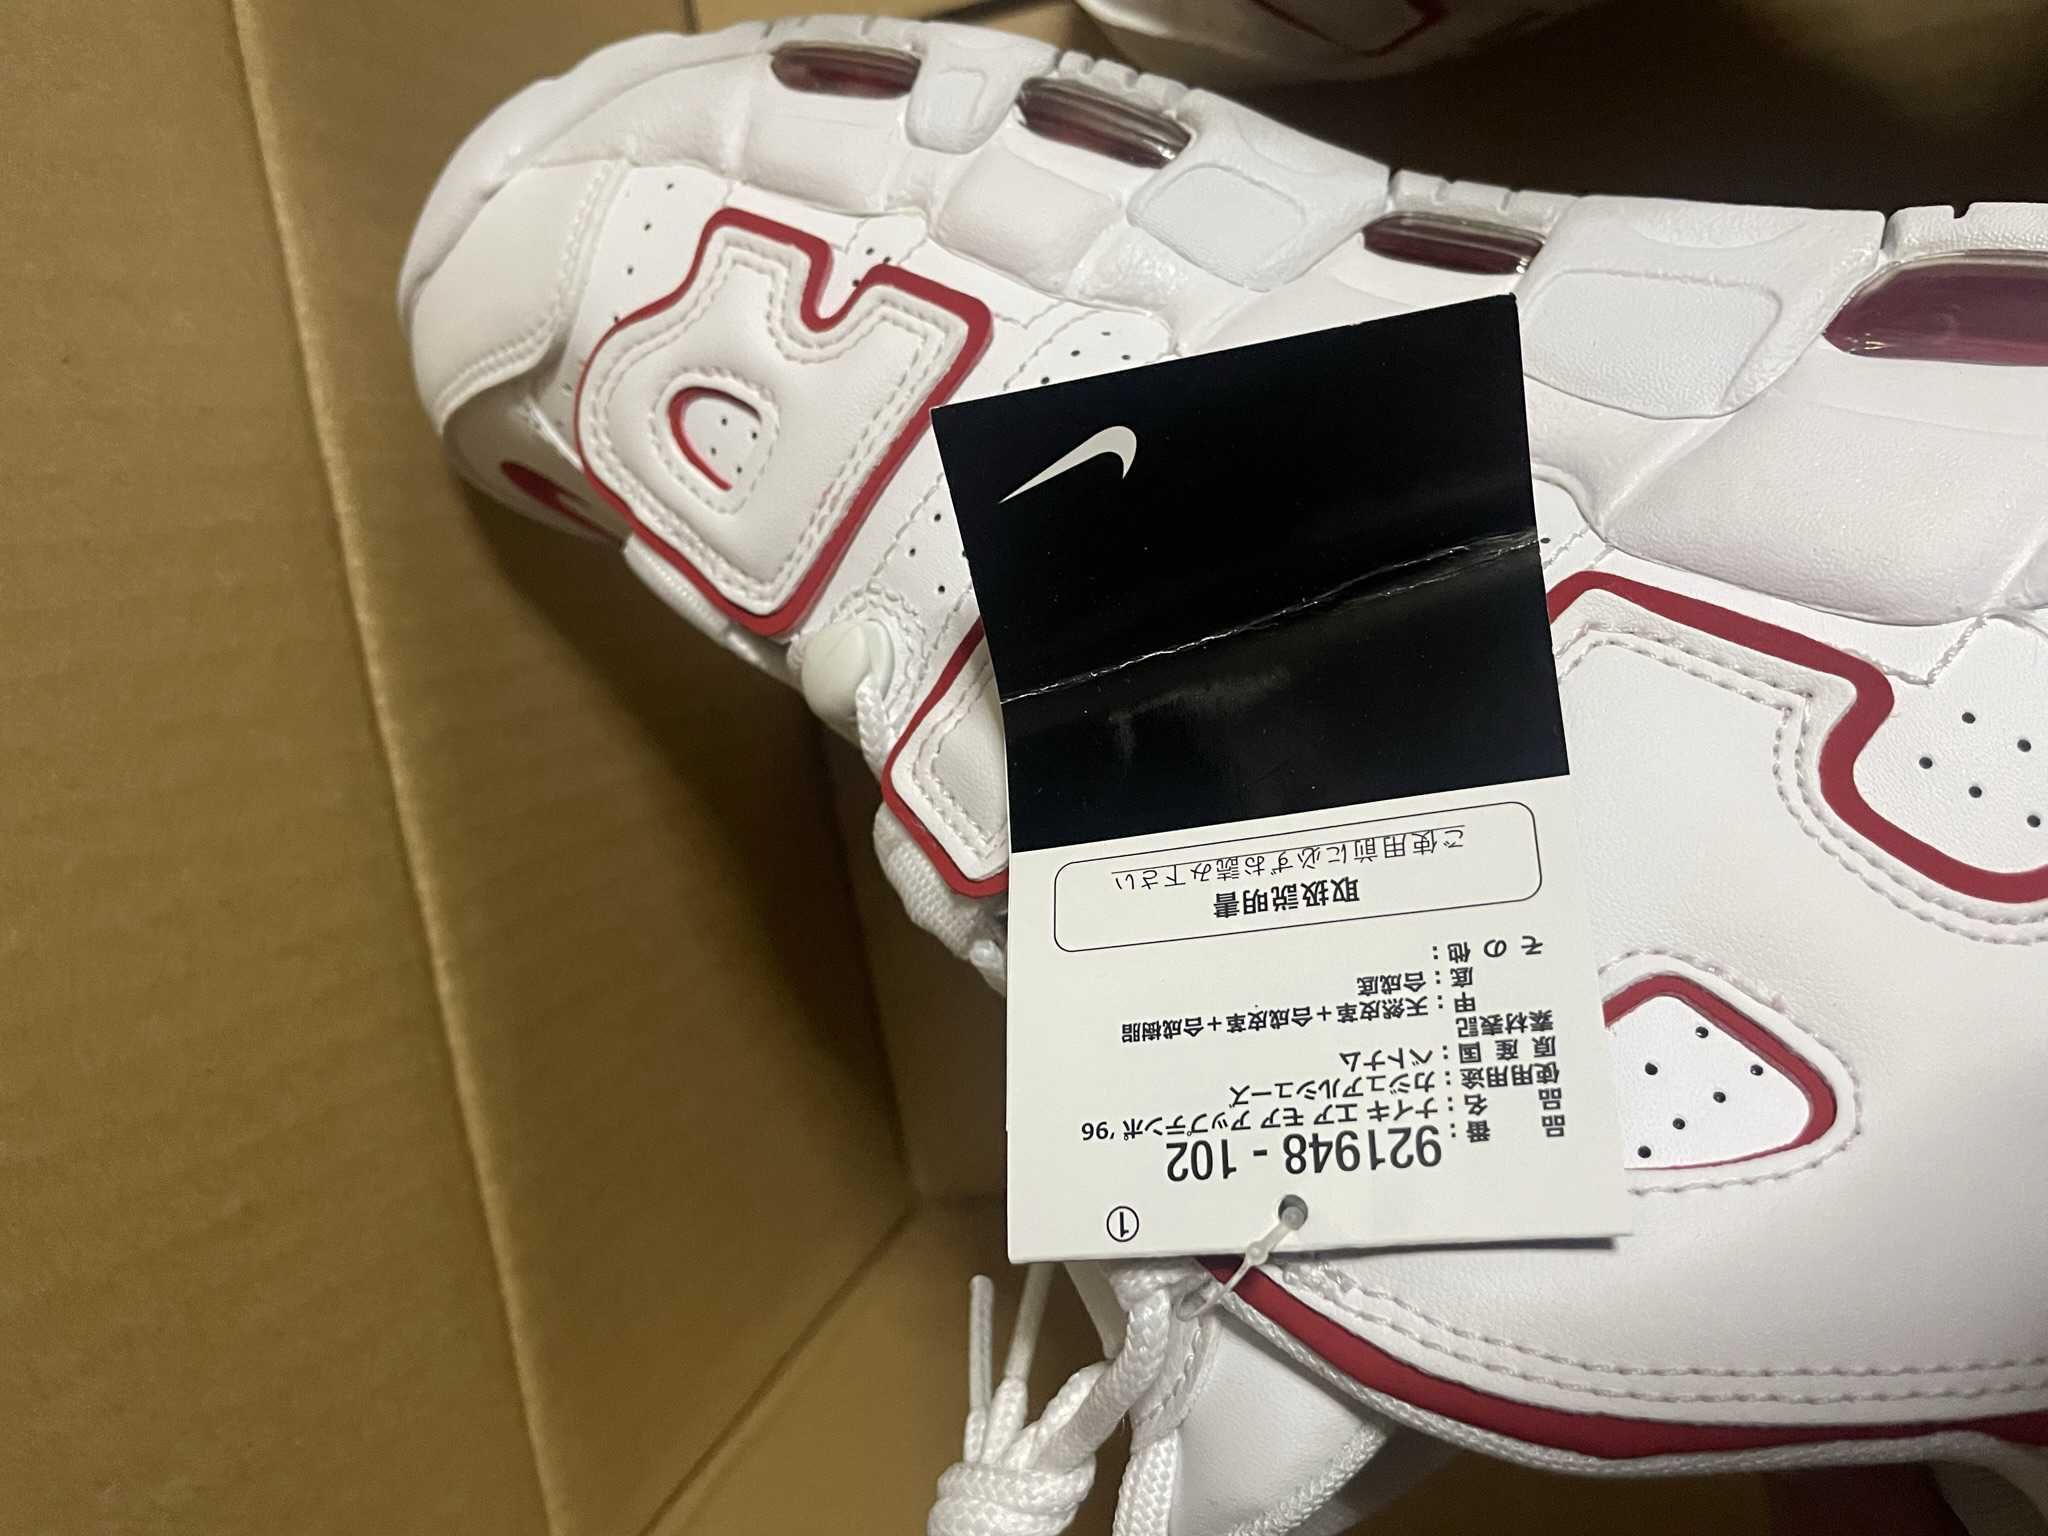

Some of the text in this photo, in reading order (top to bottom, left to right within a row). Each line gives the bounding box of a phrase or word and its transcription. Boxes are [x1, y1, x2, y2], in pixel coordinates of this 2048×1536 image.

[1110, 824, 1466, 891] ご使用前に必ずお読み下さい
[1212, 875, 1361, 919] 取扱説明書
[1356, 970, 1427, 998] 合成底
[1455, 1009, 1554, 1039] 素材表記
[1338, 1047, 1434, 1073] ベトナム
[1228, 1070, 1436, 1109] カジュアルシューズ
[1259, 1106, 1305, 1130] モア
[1312, 1102, 1359, 1126] エア
[1366, 1096, 1439, 1123] ナイキ
[1122, 1109, 1252, 1142] アップテンポ
[1165, 1138, 1238, 1183] 102
[1279, 1120, 1442, 1176] 921948
